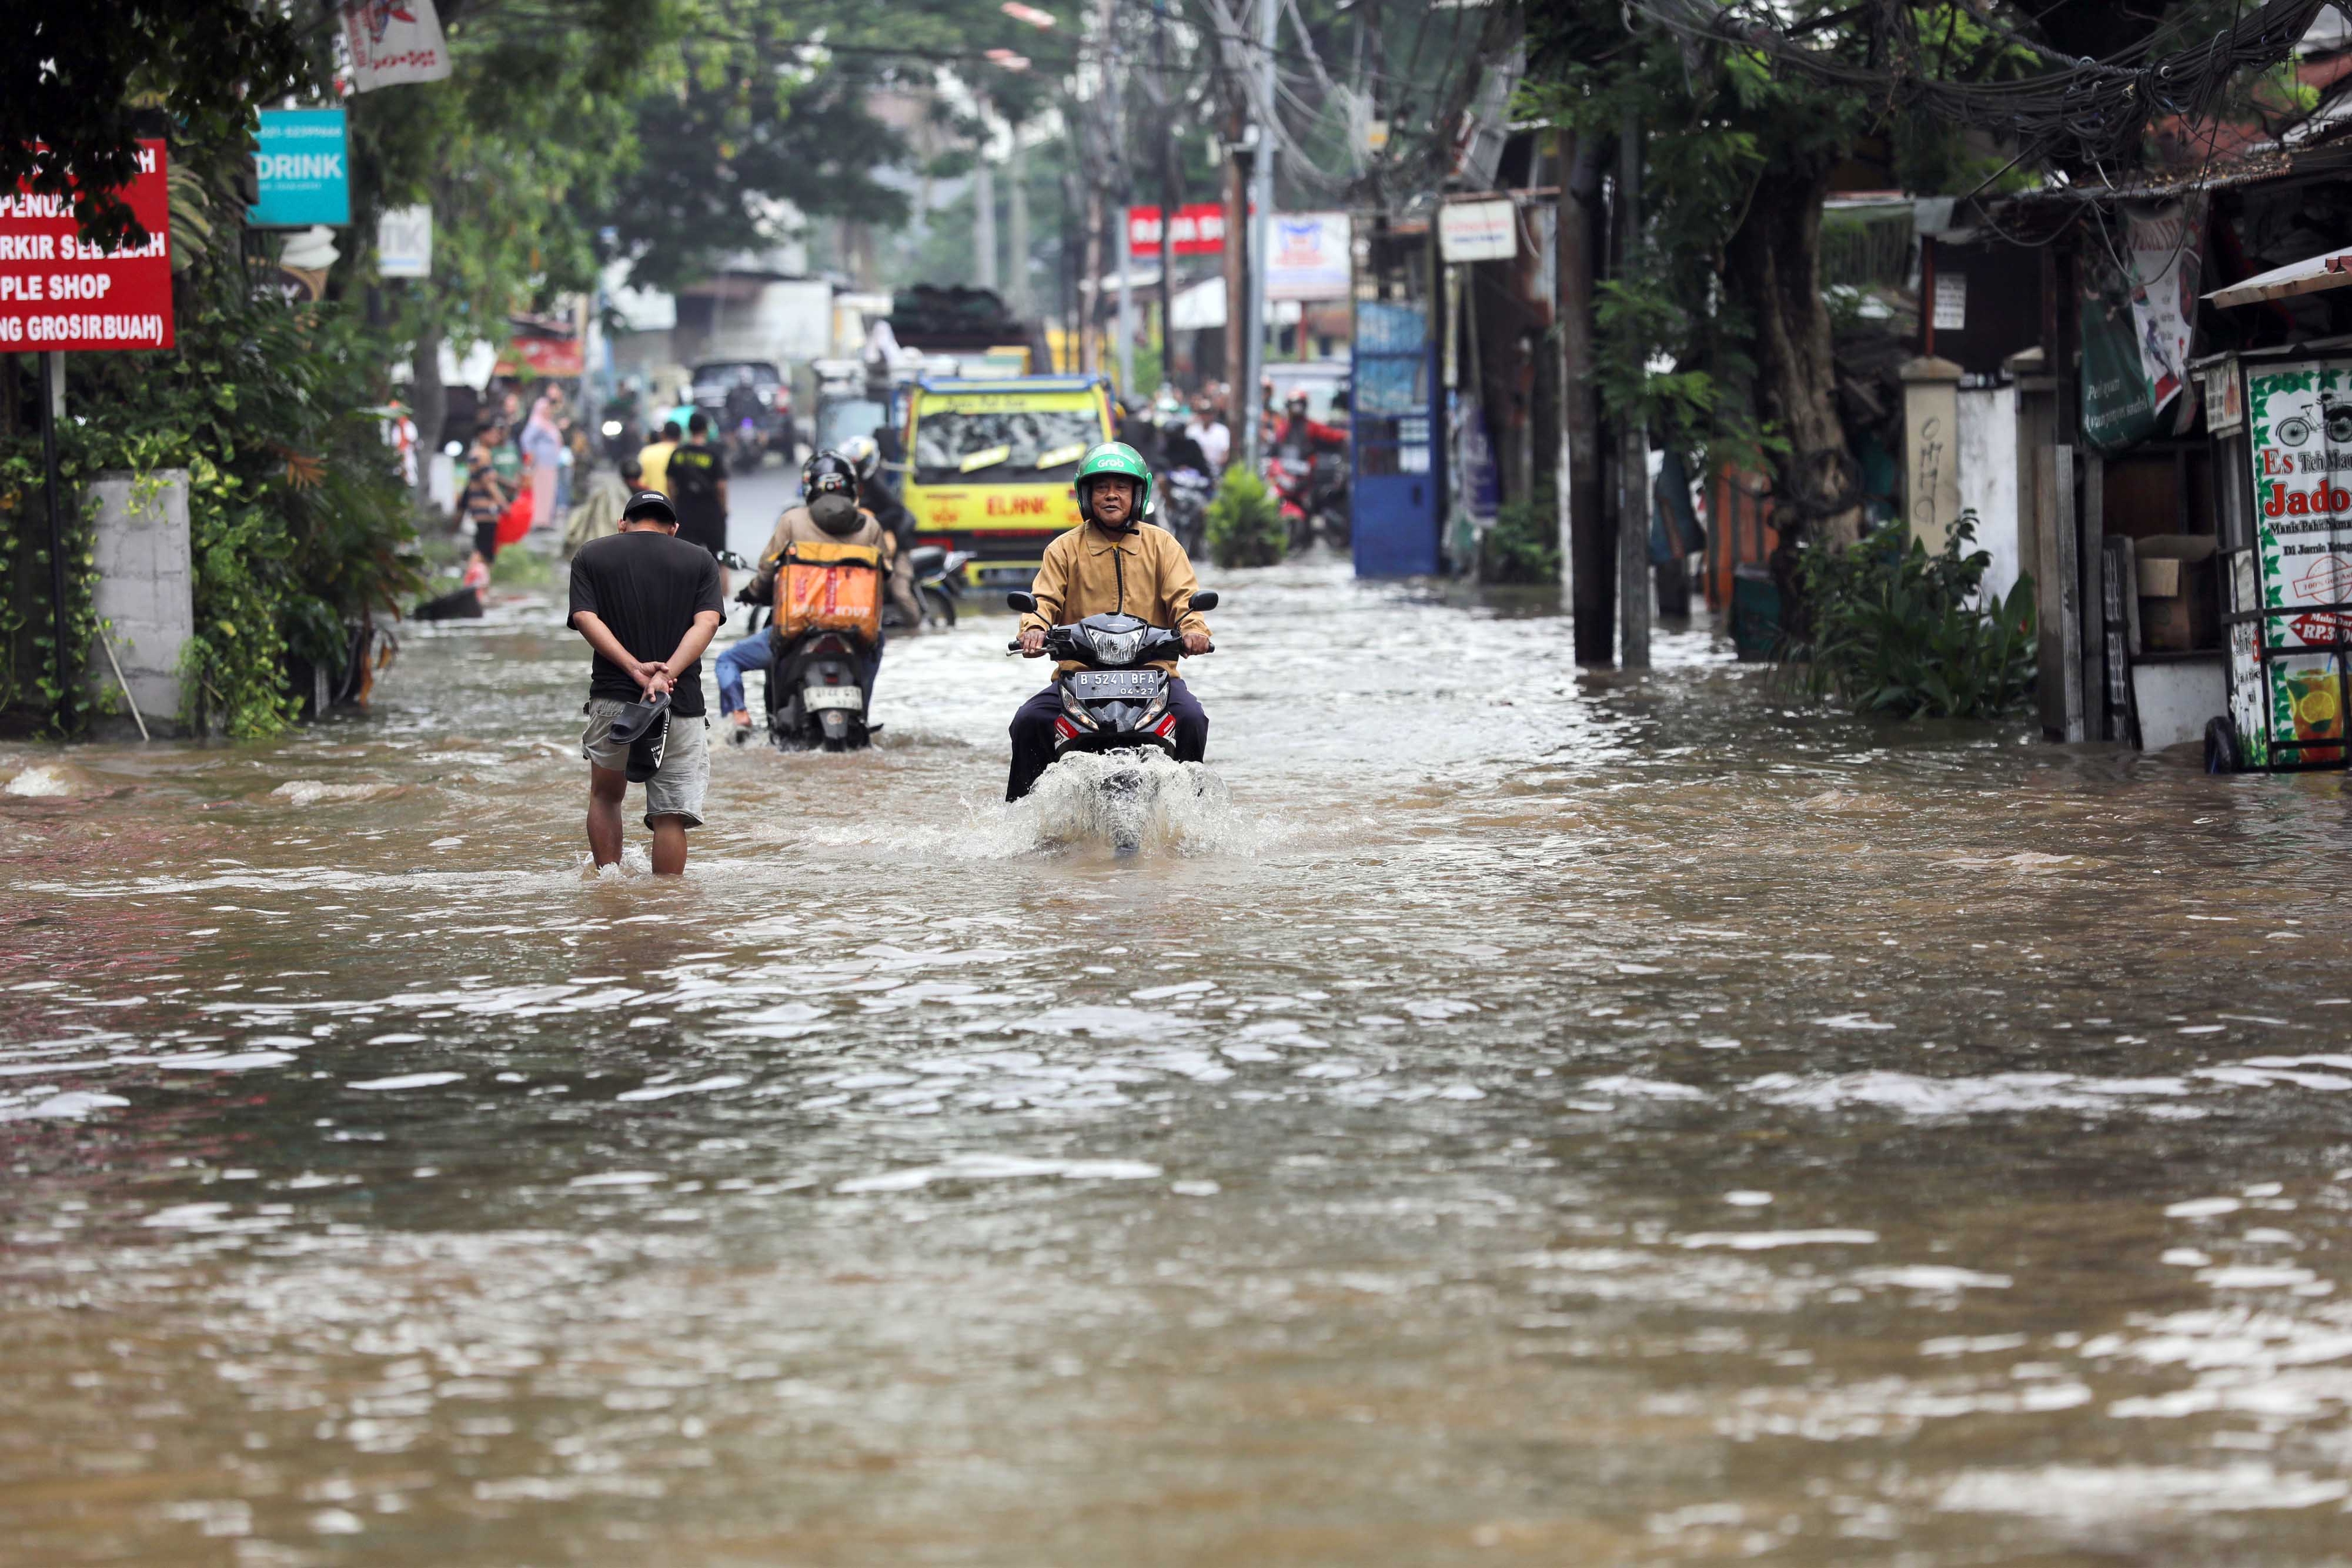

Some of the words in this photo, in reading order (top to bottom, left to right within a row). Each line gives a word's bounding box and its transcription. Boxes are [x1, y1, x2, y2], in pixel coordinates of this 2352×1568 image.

[255, 153, 343, 179] DRINK
[1, 275, 43, 301] PLE
[48, 273, 111, 300] SHOP
[27, 314, 163, 346] GROSIRBUAH)
[1098, 458, 1125, 467] Grab
[2262, 448, 2294, 476] Es
[2299, 451, 2325, 473] Teh
[2269, 522, 2298, 535] Manis
[2283, 546, 2295, 556] Di
[2298, 544, 2326, 554] Jamin
[2310, 613, 2336, 624] Mulai
[1080, 674, 1088, 685] B
[1095, 674, 1124, 685] 5241
[1131, 674, 1155, 684] BFA
